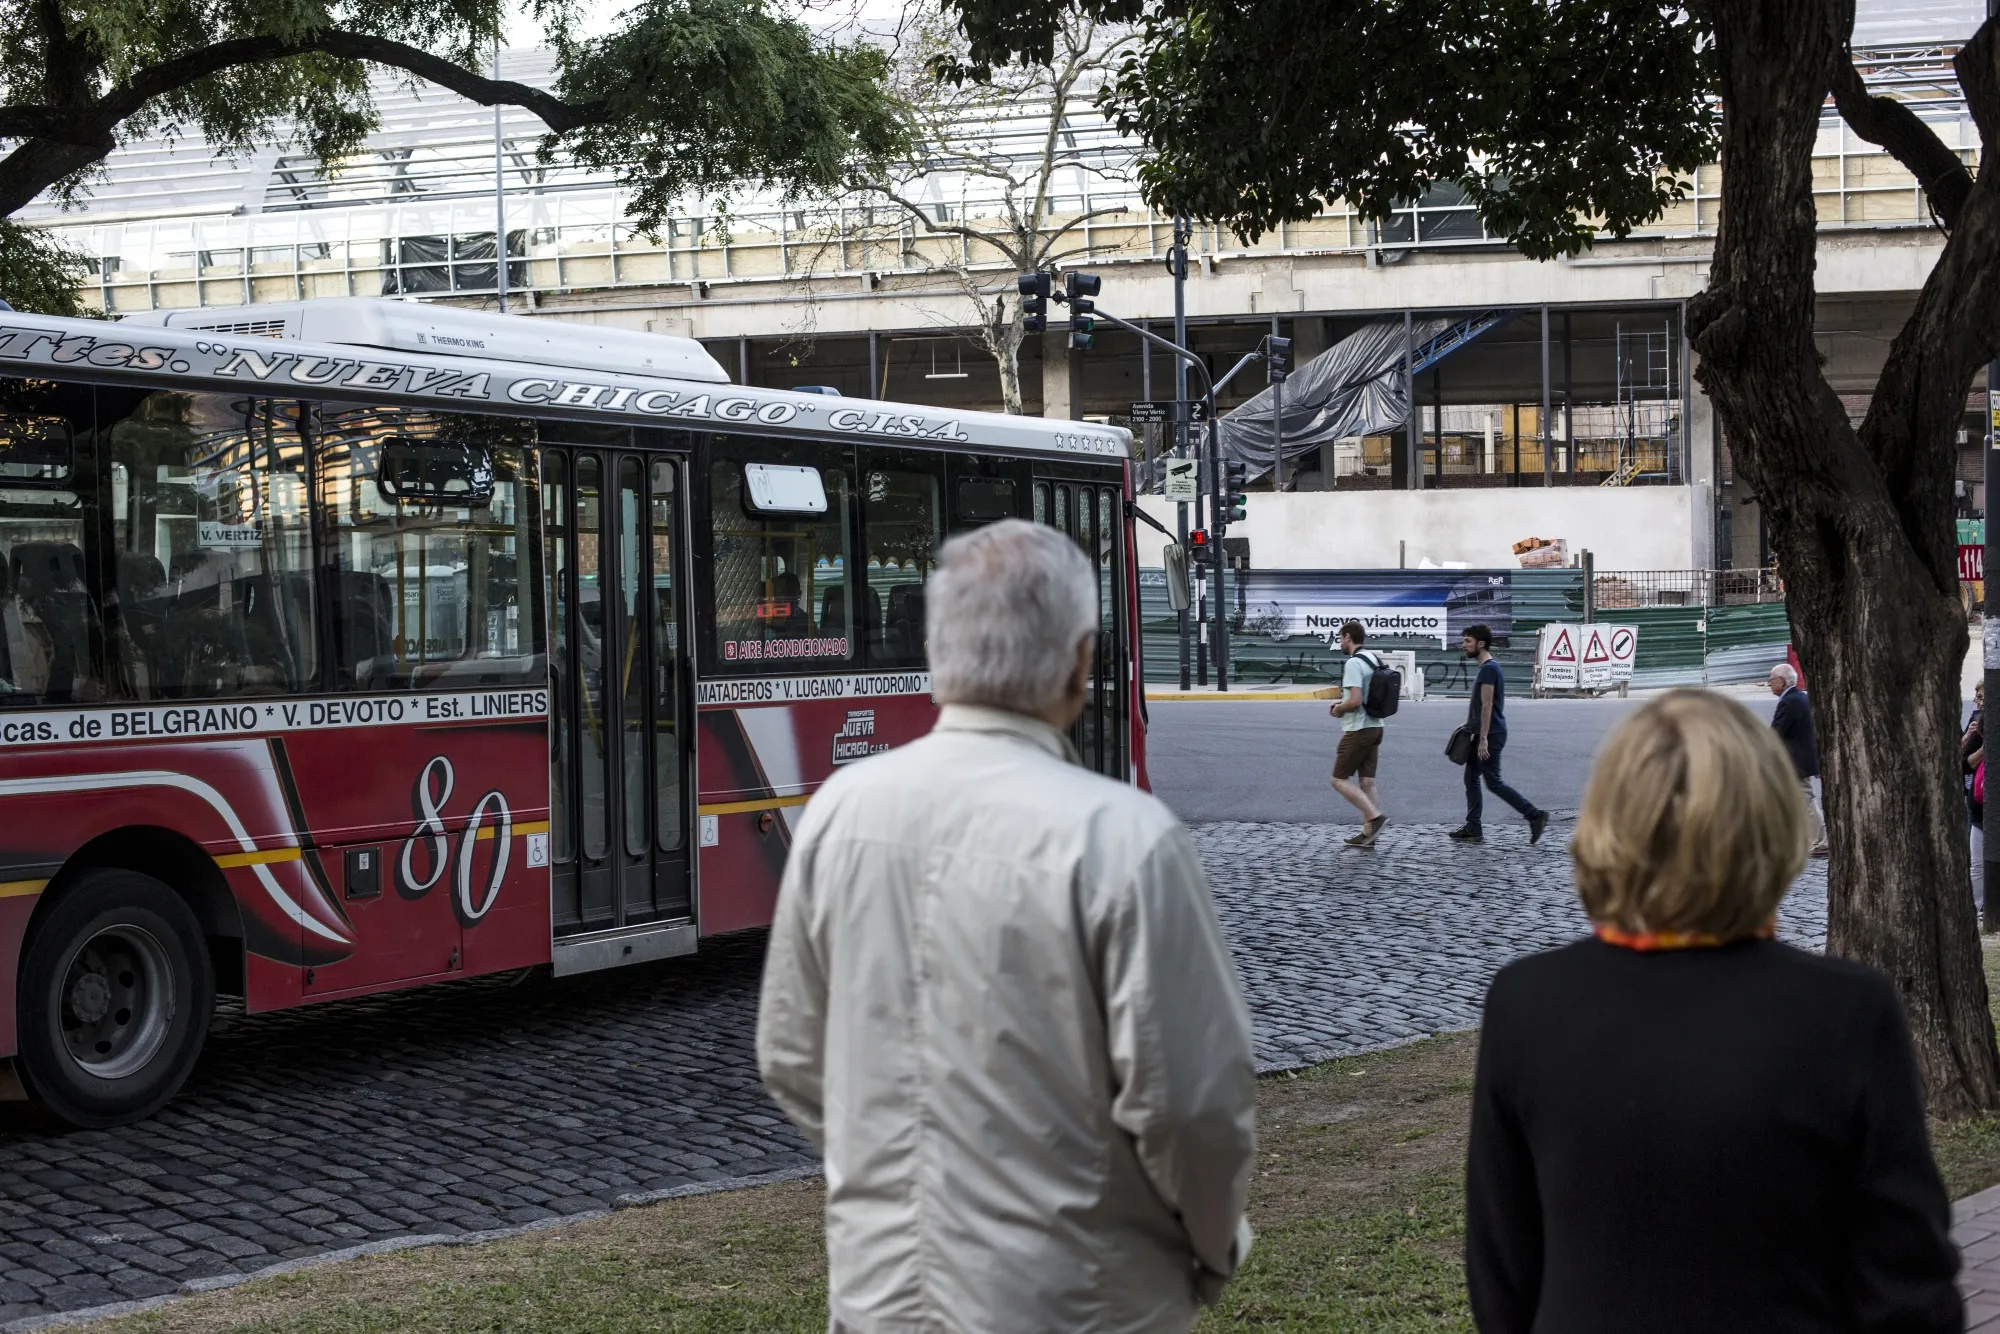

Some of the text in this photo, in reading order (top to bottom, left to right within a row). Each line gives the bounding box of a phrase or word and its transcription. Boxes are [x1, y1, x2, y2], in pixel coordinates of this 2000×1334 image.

[431, 335, 465, 347] THERMO
[466, 340, 485, 349] KING
[829, 408, 968, 442] C.I.S.A.
[200, 530, 262, 541] V. VERTIZ
[1489, 576, 1504, 585] RER
[1364, 614, 1439, 628] viaducto
[739, 637, 848, 659] AIRE ACONDICIONADO
[698, 675, 921, 703] MATADEROS V. LUGANO AUTODROMO
[0, 692, 547, 742] cas. de BELGRANO V. DEVOTO Est. LINIERS
[847, 709, 875, 718] TRANSPORTES
[842, 721, 875, 737] NUEVA
[397, 755, 514, 926] 80
